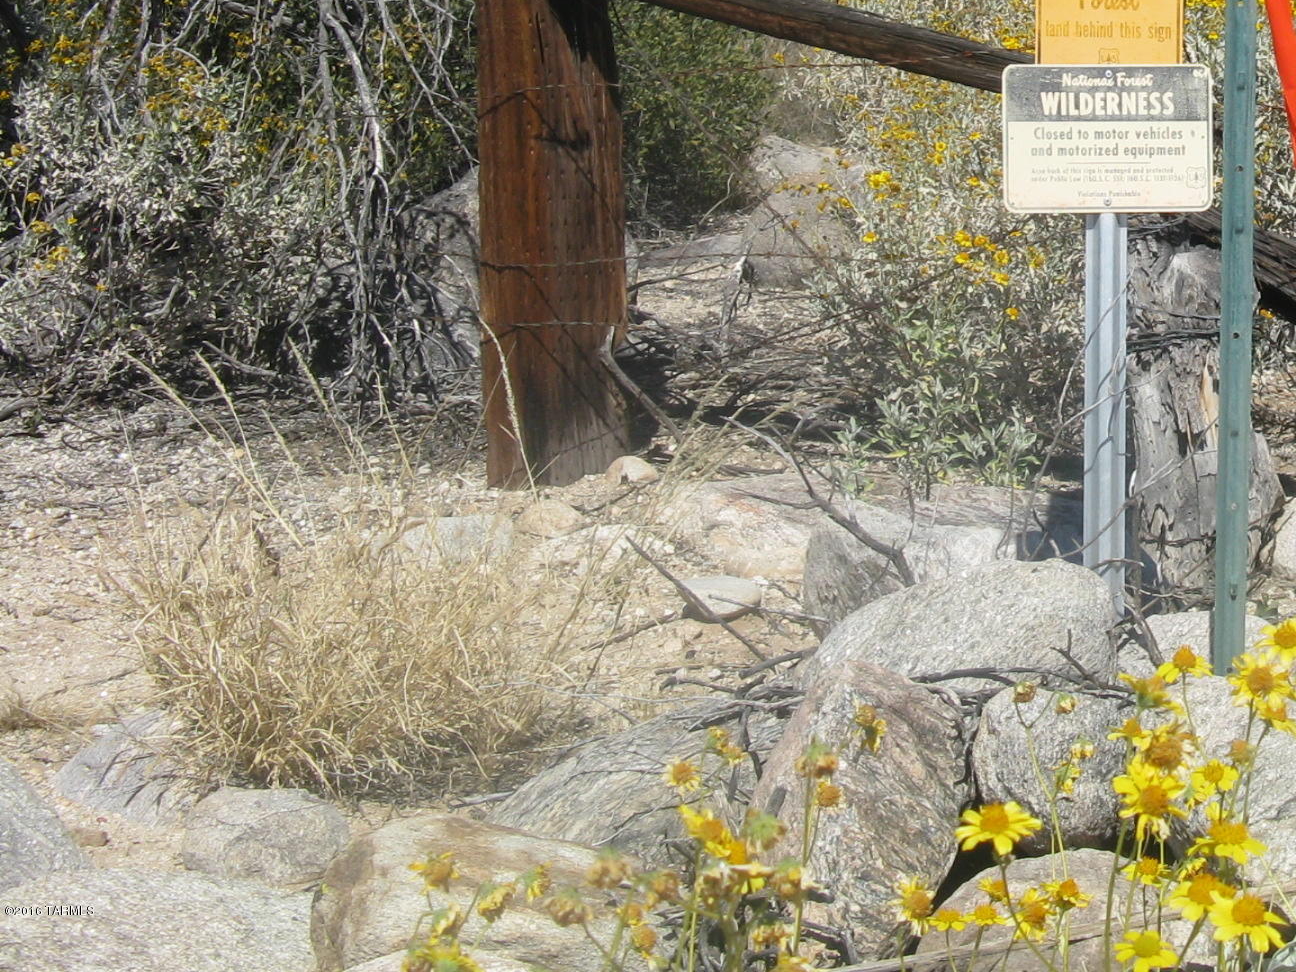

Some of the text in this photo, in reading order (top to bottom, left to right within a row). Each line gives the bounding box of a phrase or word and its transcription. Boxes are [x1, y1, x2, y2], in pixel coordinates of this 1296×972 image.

[1045, 20, 1172, 42] land behind this sign
[1061, 72, 1154, 87] National Forest
[1040, 91, 1174, 116] WILDERNESS
[1034, 126, 1183, 140] Closed to motor vehicles
[1031, 143, 1186, 159] and motorized equipment
